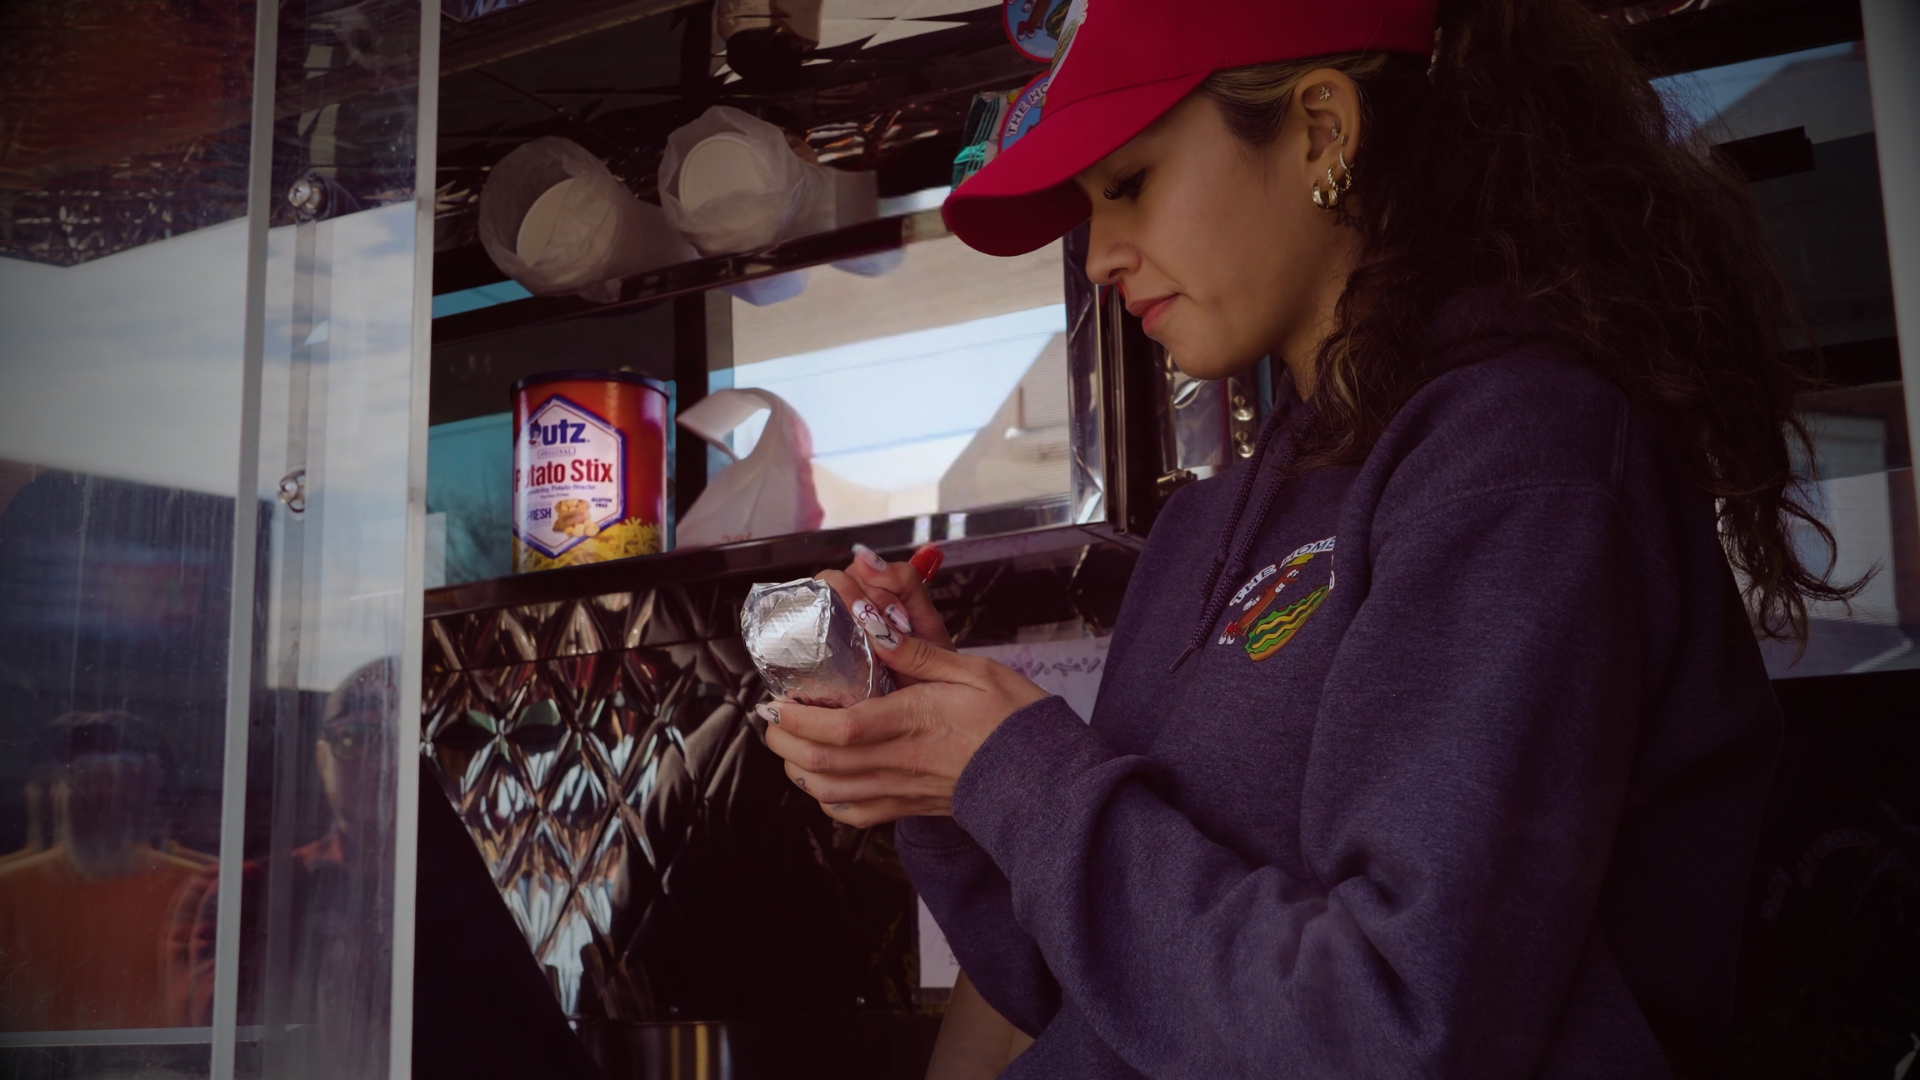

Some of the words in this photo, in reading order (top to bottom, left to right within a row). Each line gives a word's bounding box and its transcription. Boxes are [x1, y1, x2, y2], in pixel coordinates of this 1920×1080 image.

[1005, 101, 1031, 137] THE
[570, 458, 614, 483] Stix
[1228, 564, 1278, 606] THE
